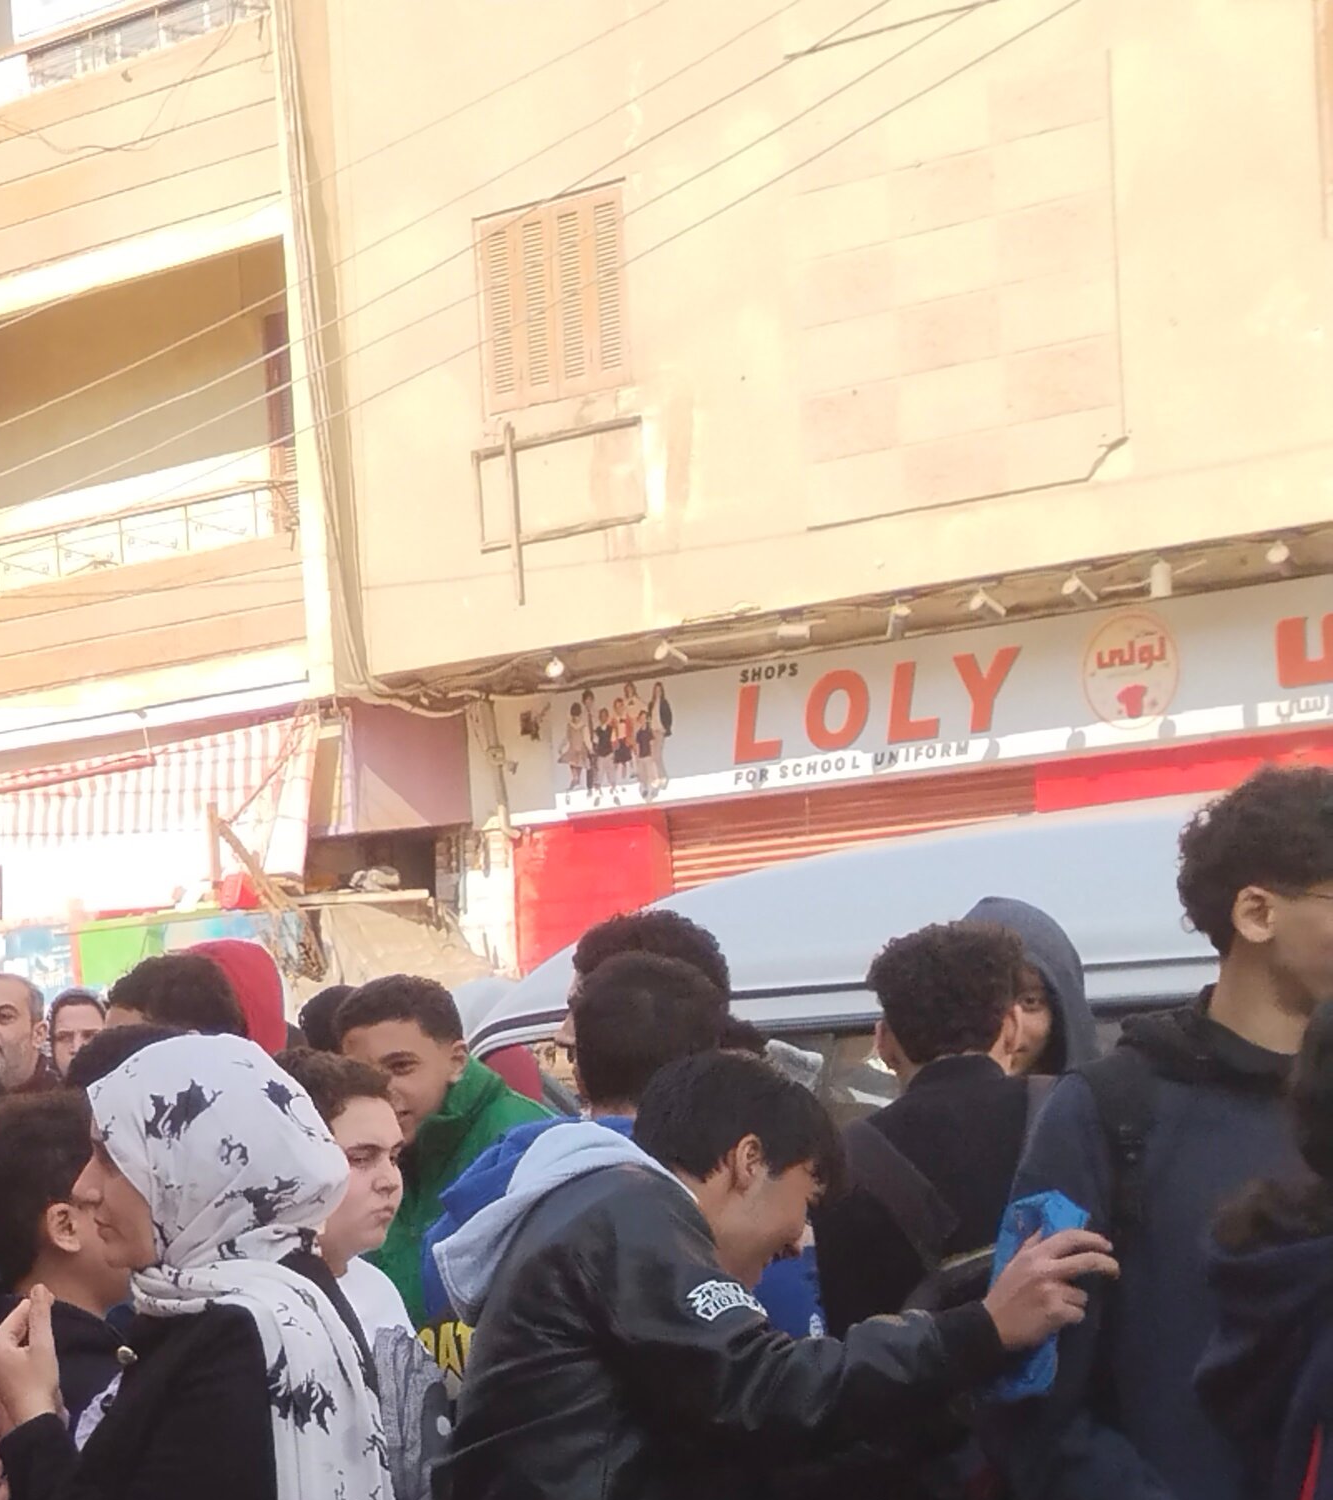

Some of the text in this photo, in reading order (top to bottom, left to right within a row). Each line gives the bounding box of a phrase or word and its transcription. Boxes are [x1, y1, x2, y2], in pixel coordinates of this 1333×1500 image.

[739, 662, 799, 683] SHOPS
[733, 645, 1023, 765] LOLY
[733, 740, 970, 786] FOR SCHOOL UNIFORM
